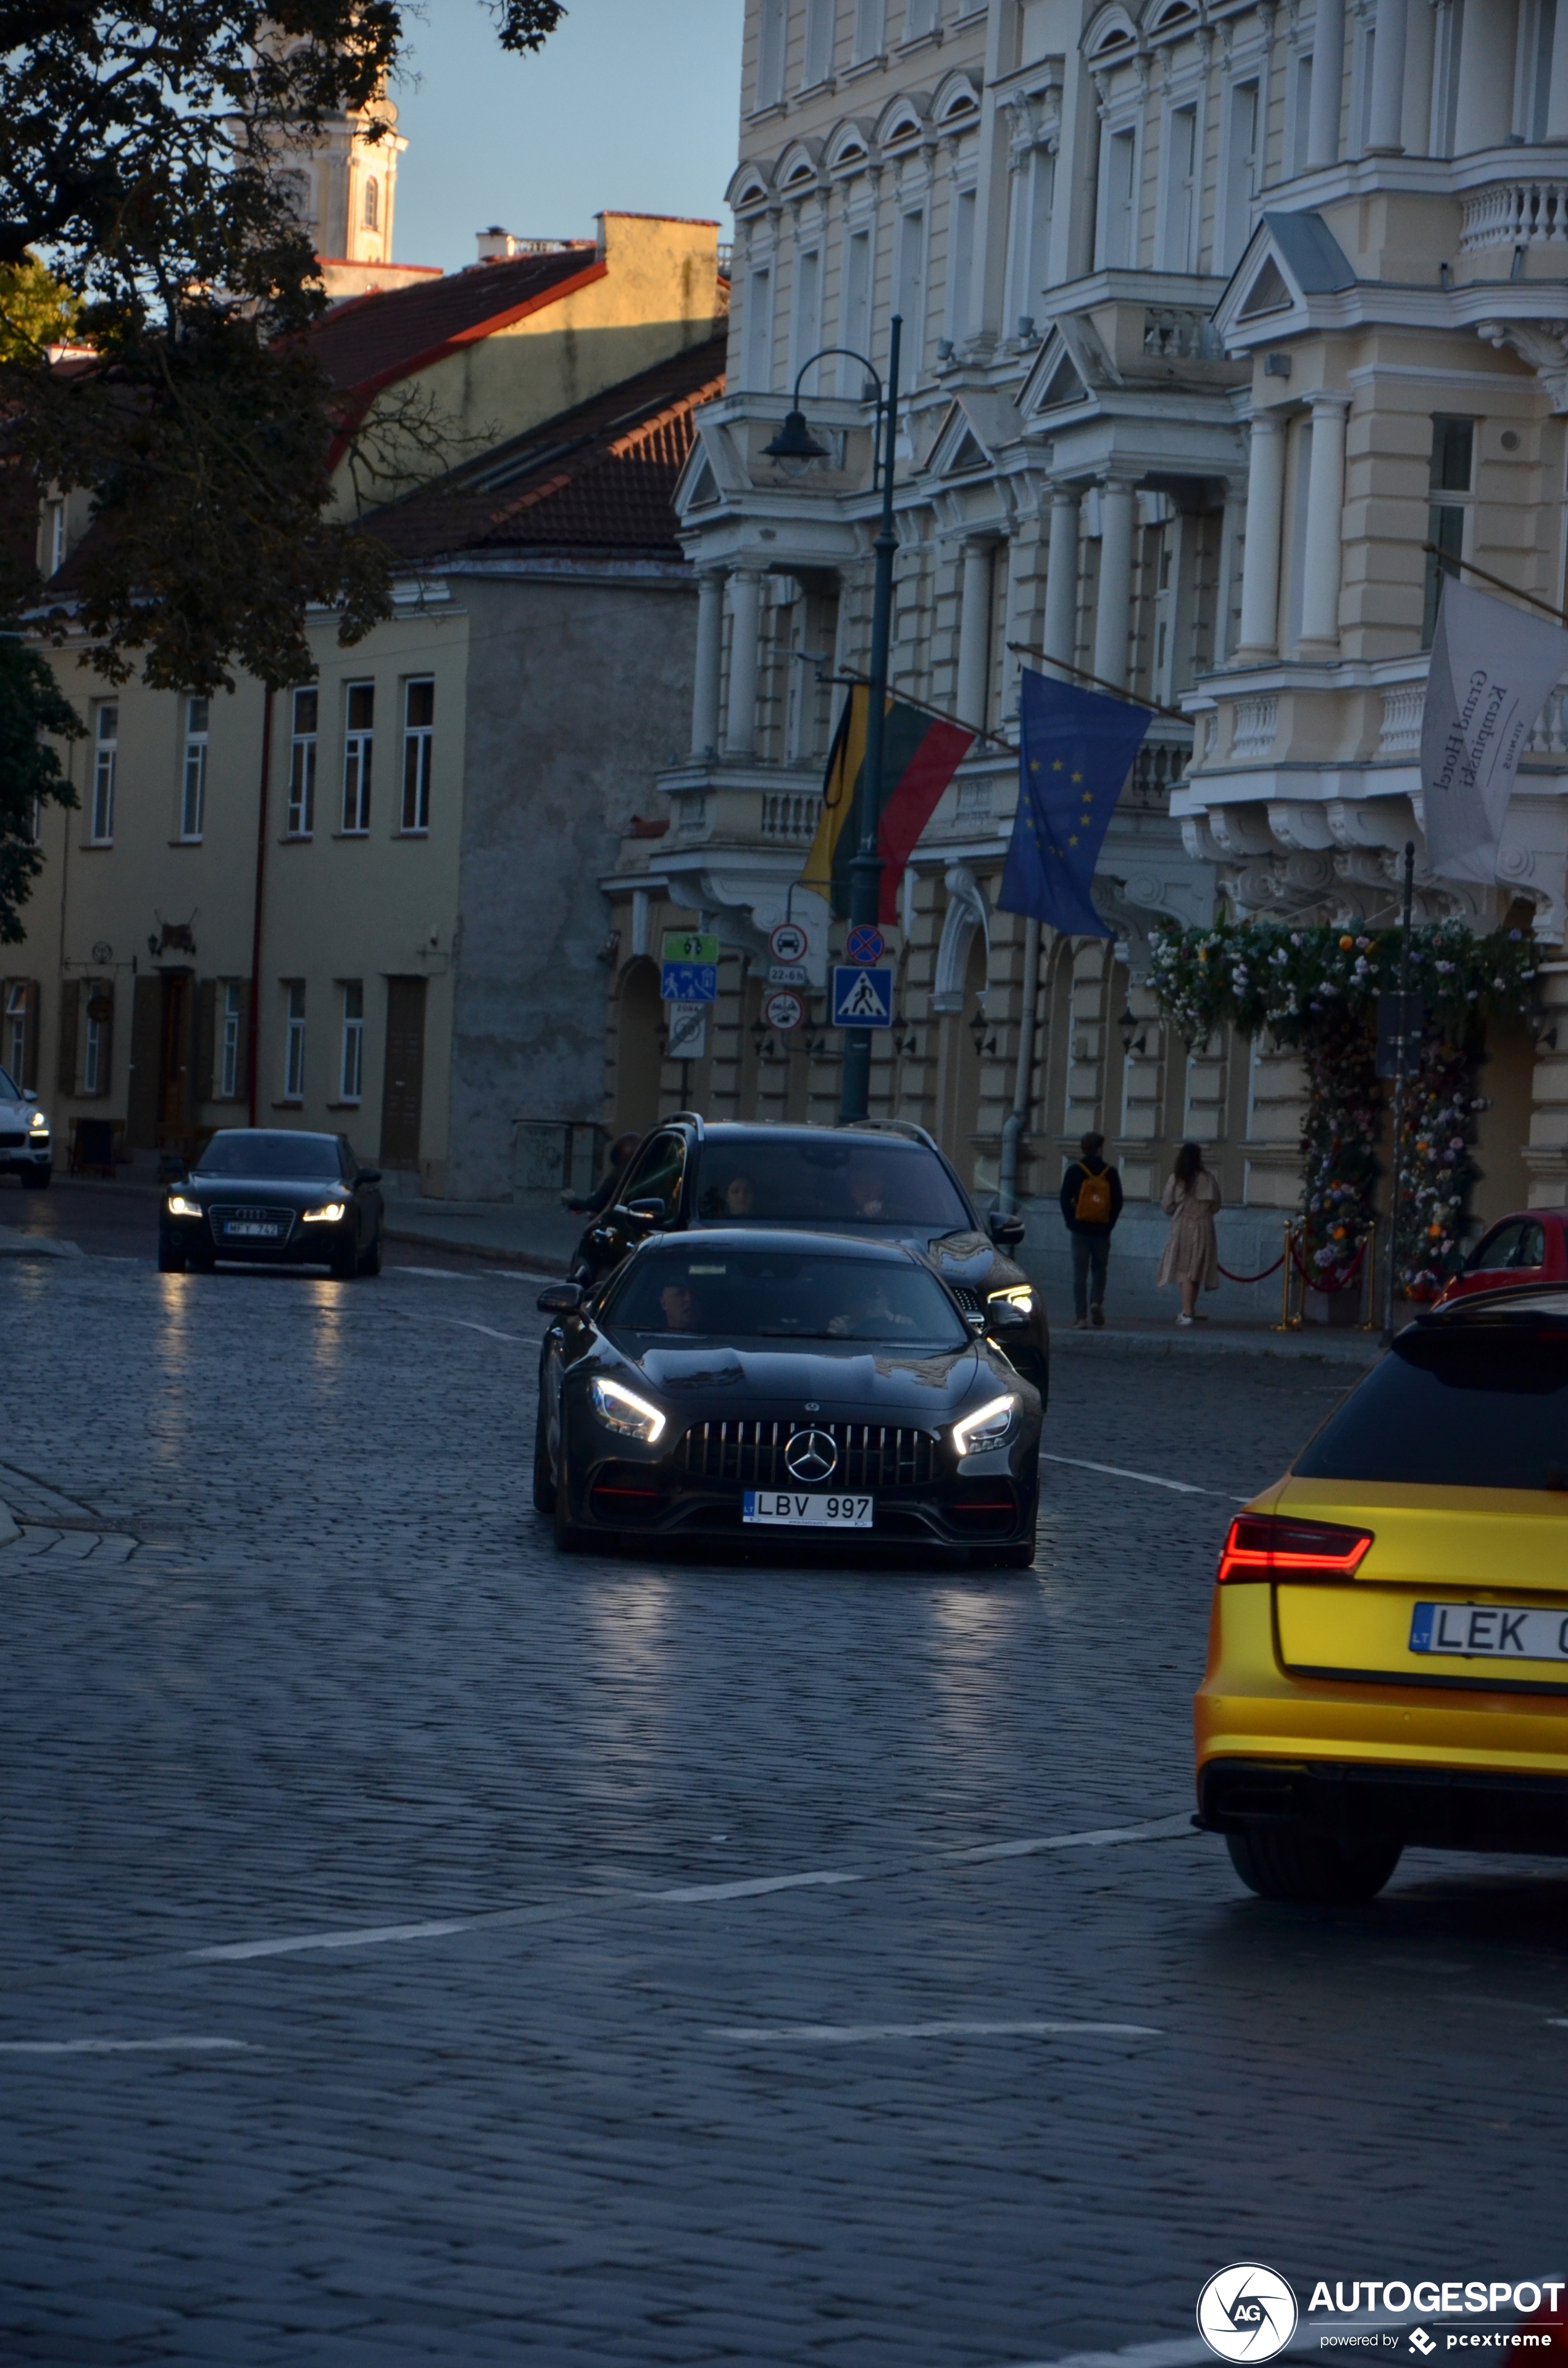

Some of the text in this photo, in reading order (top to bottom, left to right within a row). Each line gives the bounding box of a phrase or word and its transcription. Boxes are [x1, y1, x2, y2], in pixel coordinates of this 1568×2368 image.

[758, 1494, 869, 1519] LBV 997
[1412, 1633, 1429, 1643] LT
[1438, 1610, 1528, 1650] LEK
